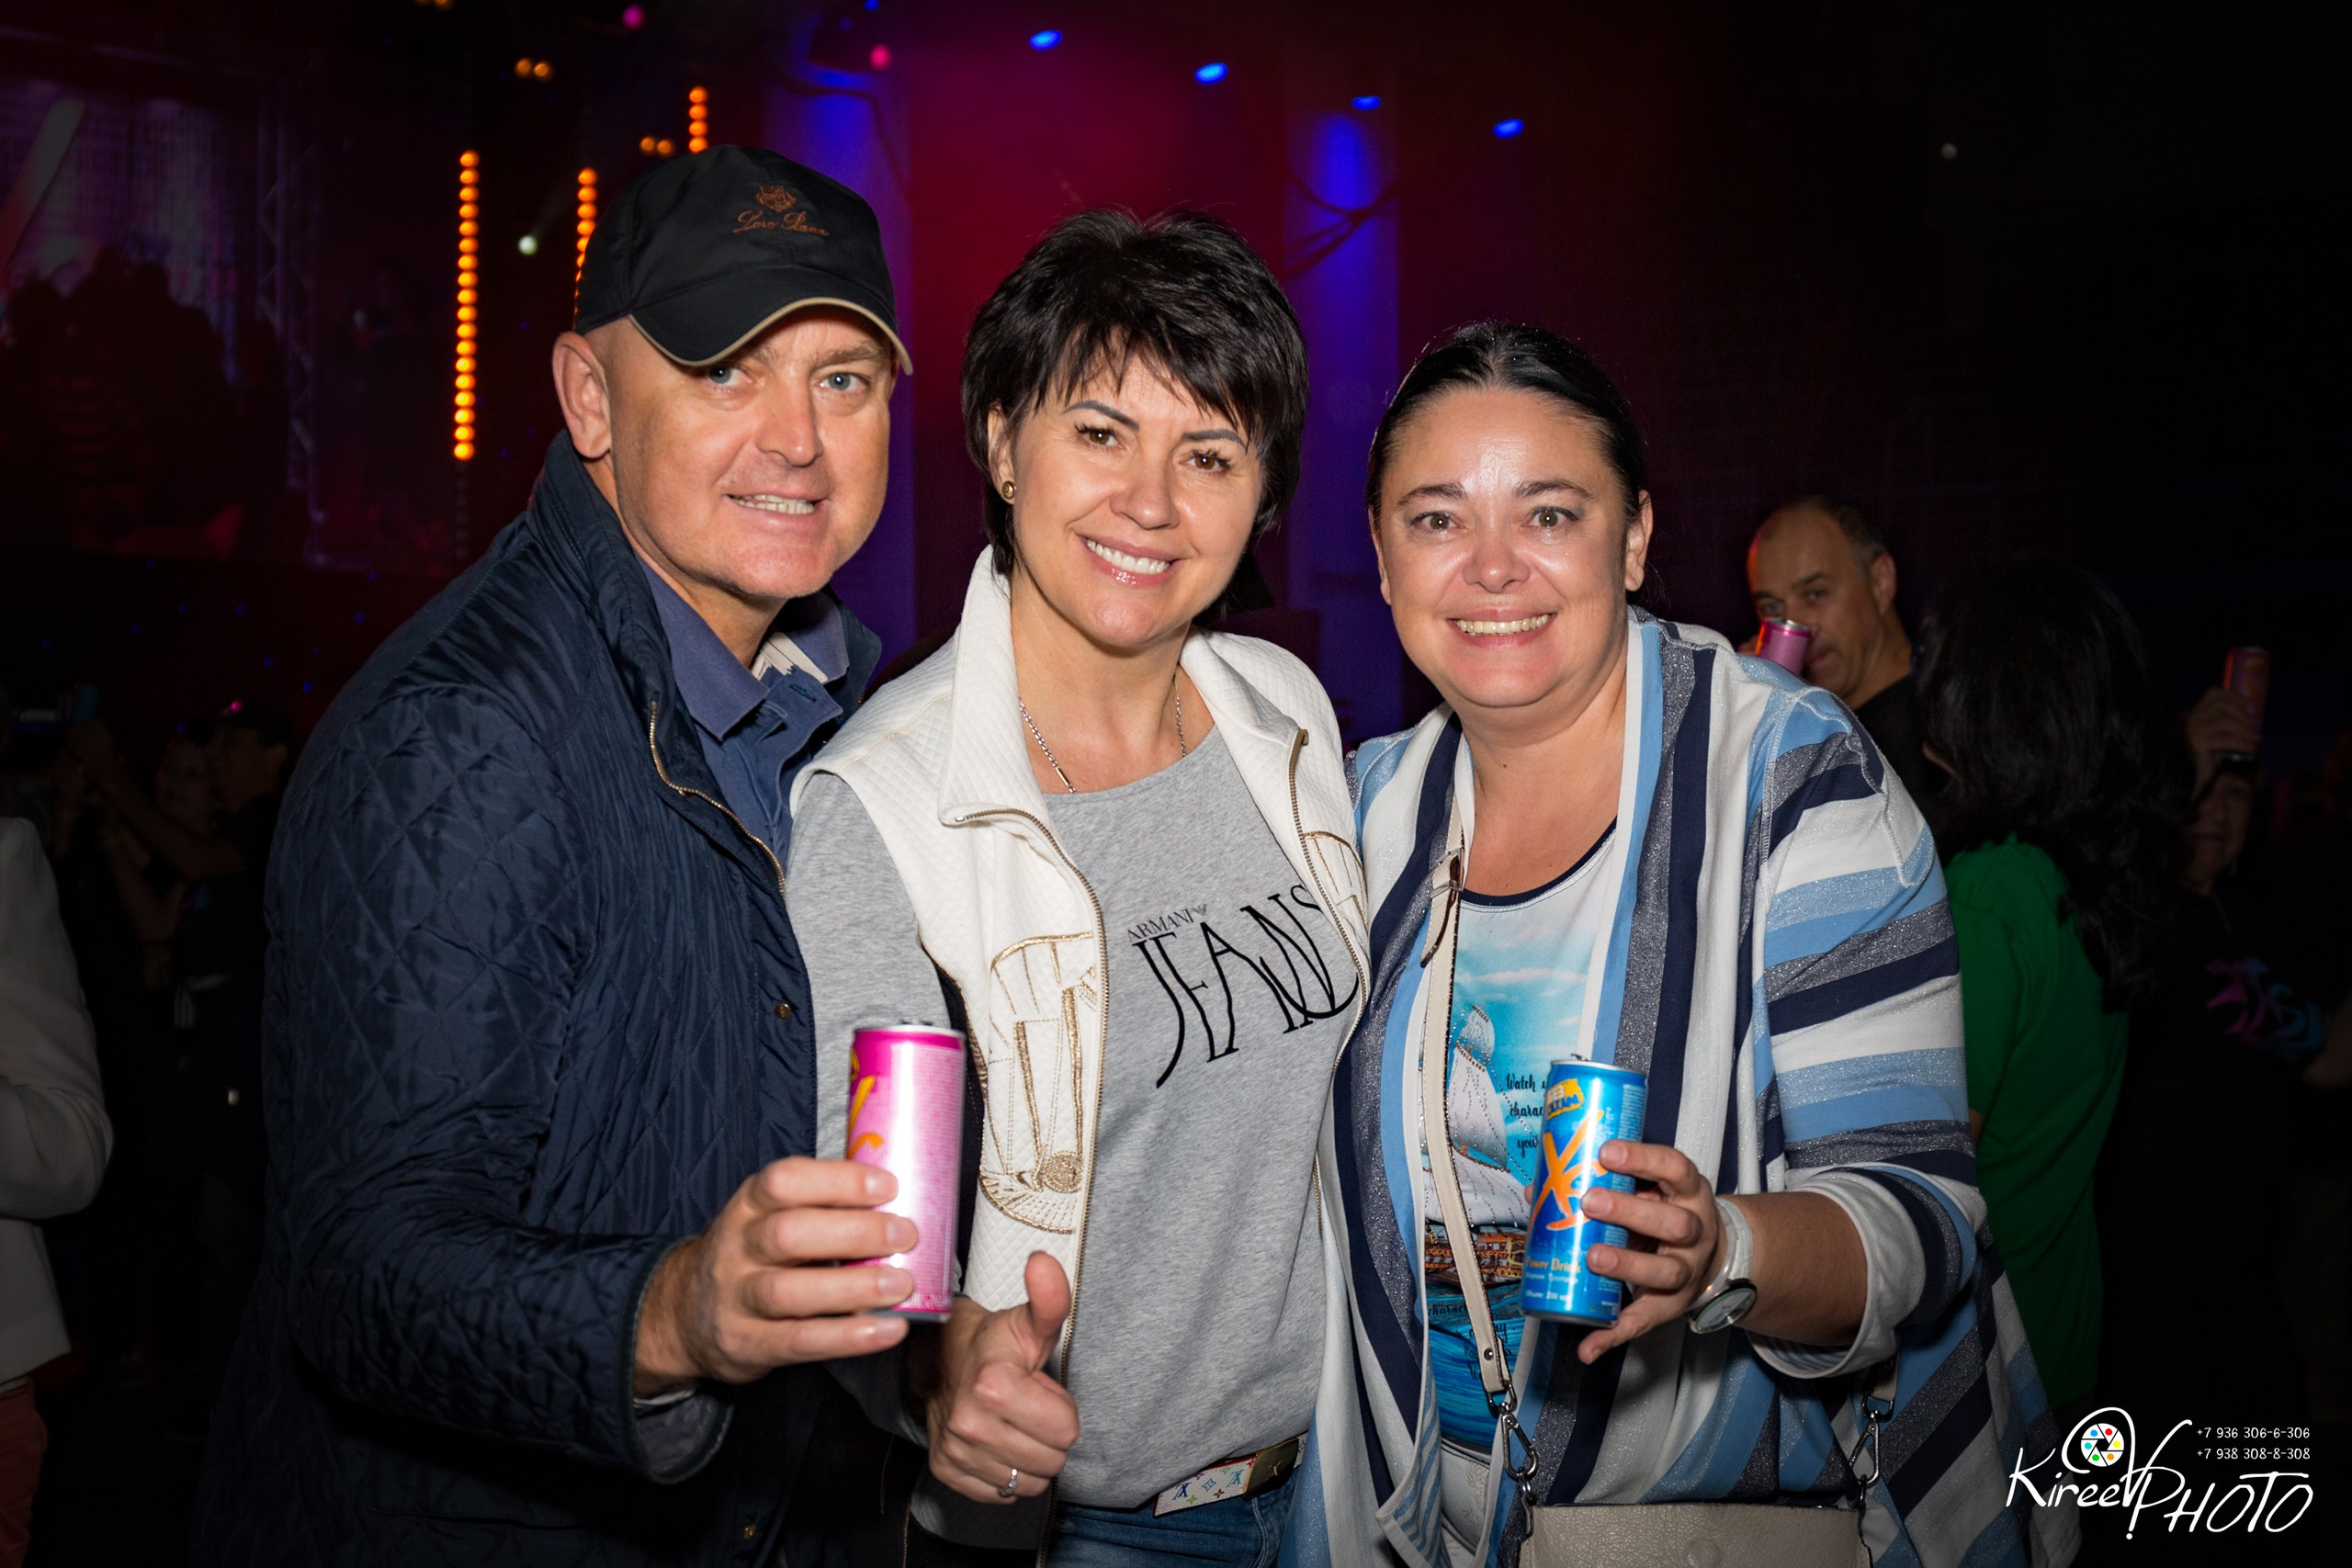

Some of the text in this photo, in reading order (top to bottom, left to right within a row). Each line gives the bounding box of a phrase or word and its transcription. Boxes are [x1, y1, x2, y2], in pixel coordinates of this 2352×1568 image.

[732, 209, 776, 235] Loro
[1127, 908, 1195, 943] ARMANI
[1506, 1072, 1536, 1093] Watch
